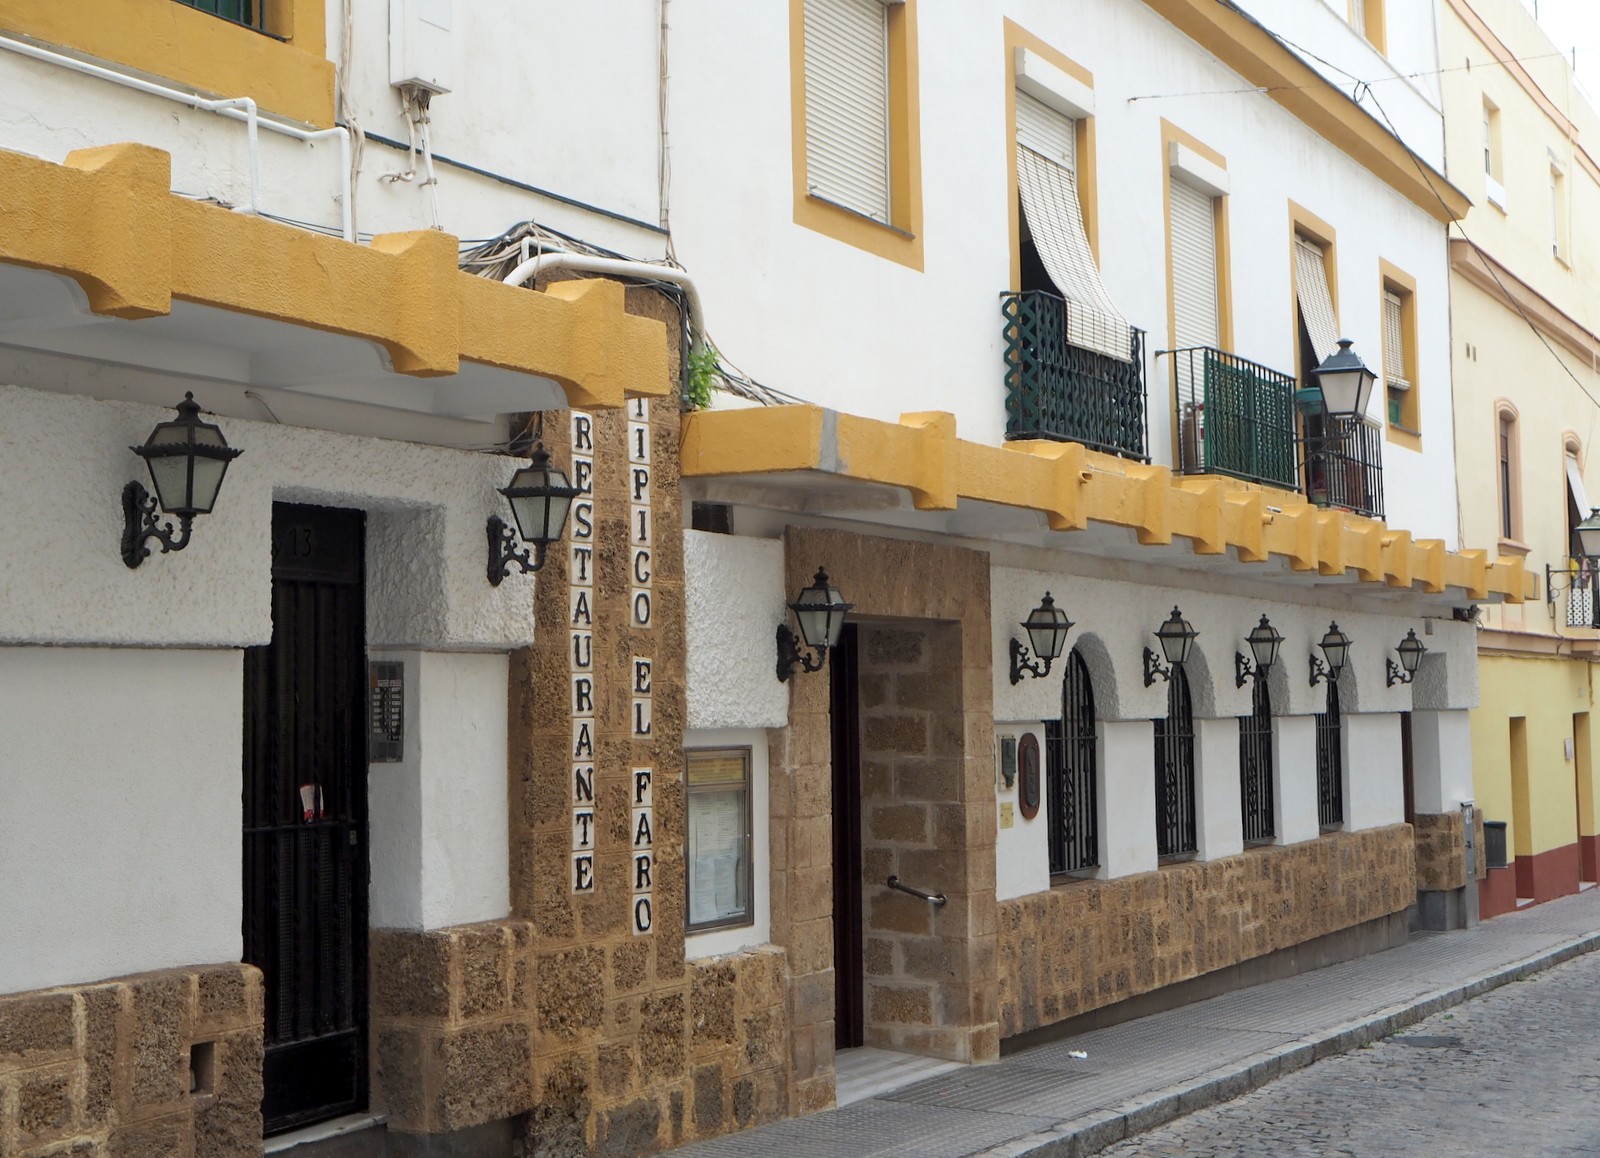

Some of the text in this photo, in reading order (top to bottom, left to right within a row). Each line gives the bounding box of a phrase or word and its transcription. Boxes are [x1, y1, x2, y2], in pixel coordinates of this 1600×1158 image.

[288, 527, 312, 558] 13
[573, 416, 594, 890] RESTAURANTE
[635, 661, 651, 735] EL
[635, 772, 652, 931] FARO
